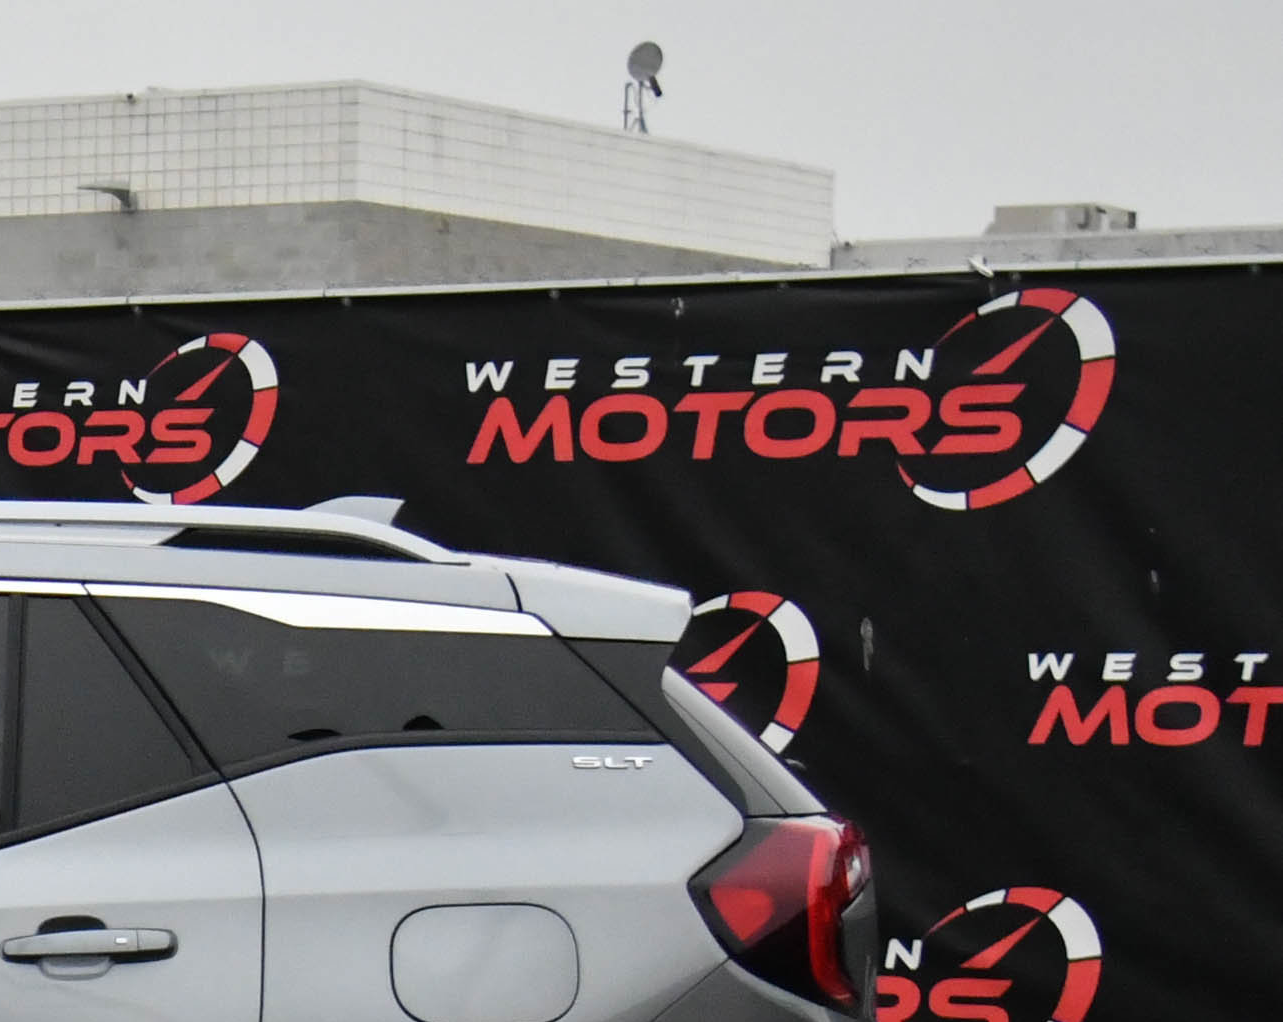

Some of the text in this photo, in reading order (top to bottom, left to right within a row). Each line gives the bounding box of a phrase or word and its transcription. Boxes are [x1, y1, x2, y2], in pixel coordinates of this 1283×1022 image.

[465, 348, 934, 393] WESTERN
[467, 383, 1026, 465] MOTORS
[1028, 652, 1268, 681] WEST
[572, 756, 654, 769] SLT
